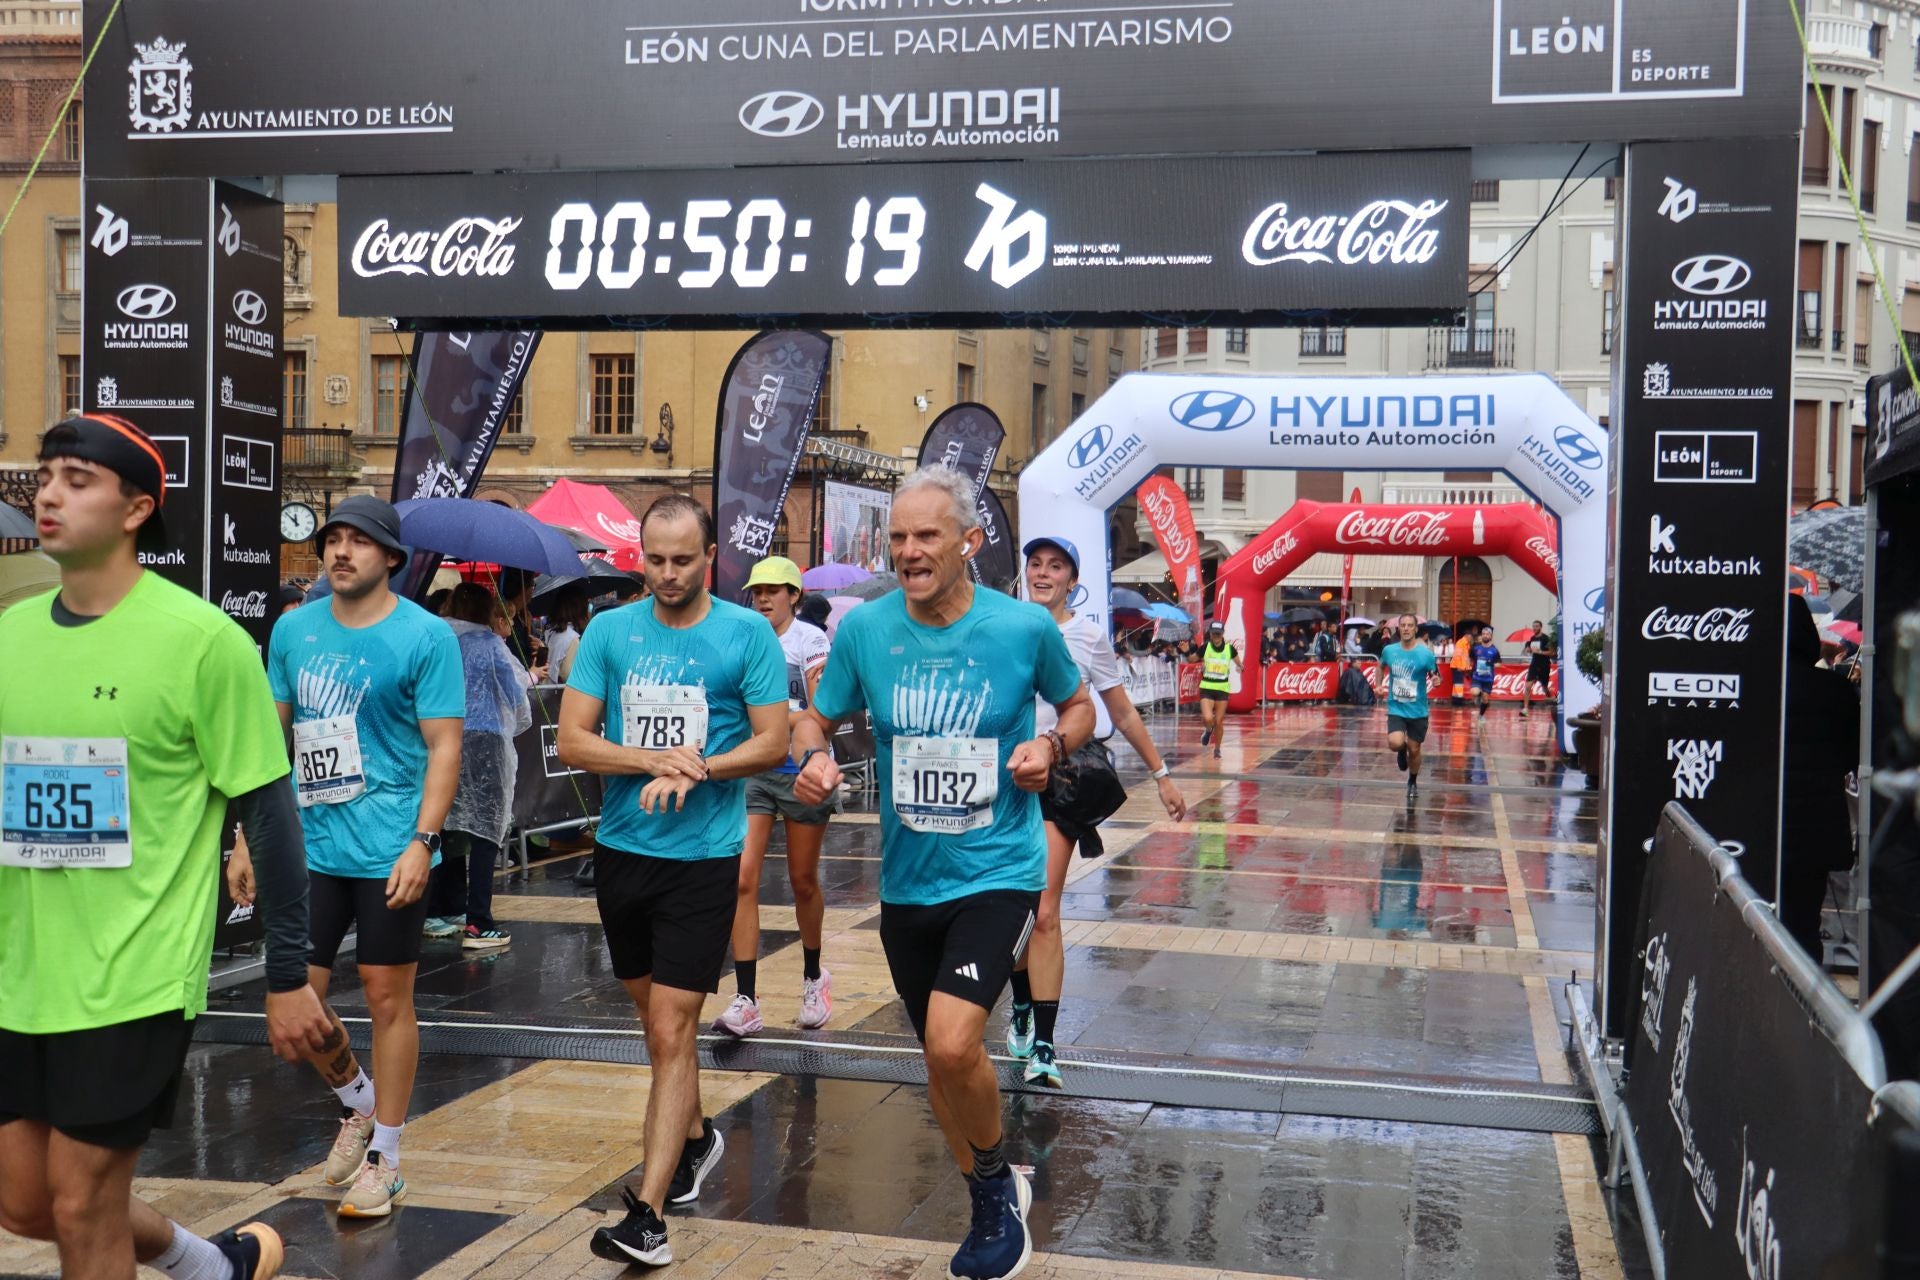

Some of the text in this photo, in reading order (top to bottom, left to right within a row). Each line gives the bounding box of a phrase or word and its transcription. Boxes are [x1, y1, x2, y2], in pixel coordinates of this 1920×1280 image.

[625, 16, 1232, 65] LEÓN CUNA DEL PARLAMENTARISMO
[1510, 16, 1604, 56] LEÓN
[1632, 50, 1652, 64] ES
[1631, 65, 1710, 82] DEPORTE
[197, 102, 453, 129] AYUNTAMIENTO DE LEÓN
[837, 87, 1060, 130] HYUNDAI
[837, 126, 1060, 149] Lemauto Automoción
[1241, 198, 1448, 266] Coca-Cola
[351, 216, 522, 278] Coca-Cola
[1654, 300, 1766, 318] HYUNDAI
[104, 323, 188, 339] HYUNDAI
[1654, 319, 1766, 330] Lemauto Automoción
[104, 340, 188, 349] Lemauto Automoción
[225, 323, 274, 350] HYUNDAI
[178, 398, 194, 406] LEÓN
[1671, 386, 1773, 396] AYUNTAMIENTO DE LEÓN
[465, 338, 526, 476] AYUNTAMIENTO
[1270, 394, 1495, 427] HYUNDAI
[1270, 429, 1495, 446] Lemauto Automoción
[225, 452, 246, 468] LEÓN
[1074, 433, 1141, 496] HYUNDAI
[1523, 434, 1594, 498] HYUNDAI
[1661, 447, 1701, 463] LEÓN
[1336, 510, 1453, 545] Coca-Cola
[138, 549, 186, 565] abank
[224, 546, 271, 564] kutxabank
[1252, 531, 1298, 575] Coca-Cola
[1649, 555, 1761, 575] kutxabank
[221, 590, 268, 618] Coca-Cola
[1641, 606, 1755, 642] Coca-Cola
[1274, 667, 1330, 695] Coca-Cola
[1653, 677, 1737, 693] LEON
[1648, 698, 1739, 708] PLAZA
[637, 716, 685, 747] 783
[545, 739, 558, 757] LEÓ
[301, 747, 342, 782] 862
[315, 787, 352, 799] HYUNDAI
[913, 769, 977, 806] 1032
[25, 782, 94, 829] 635
[932, 815, 976, 826] HYUNDAI
[40, 847, 106, 858] HYUNDAI
